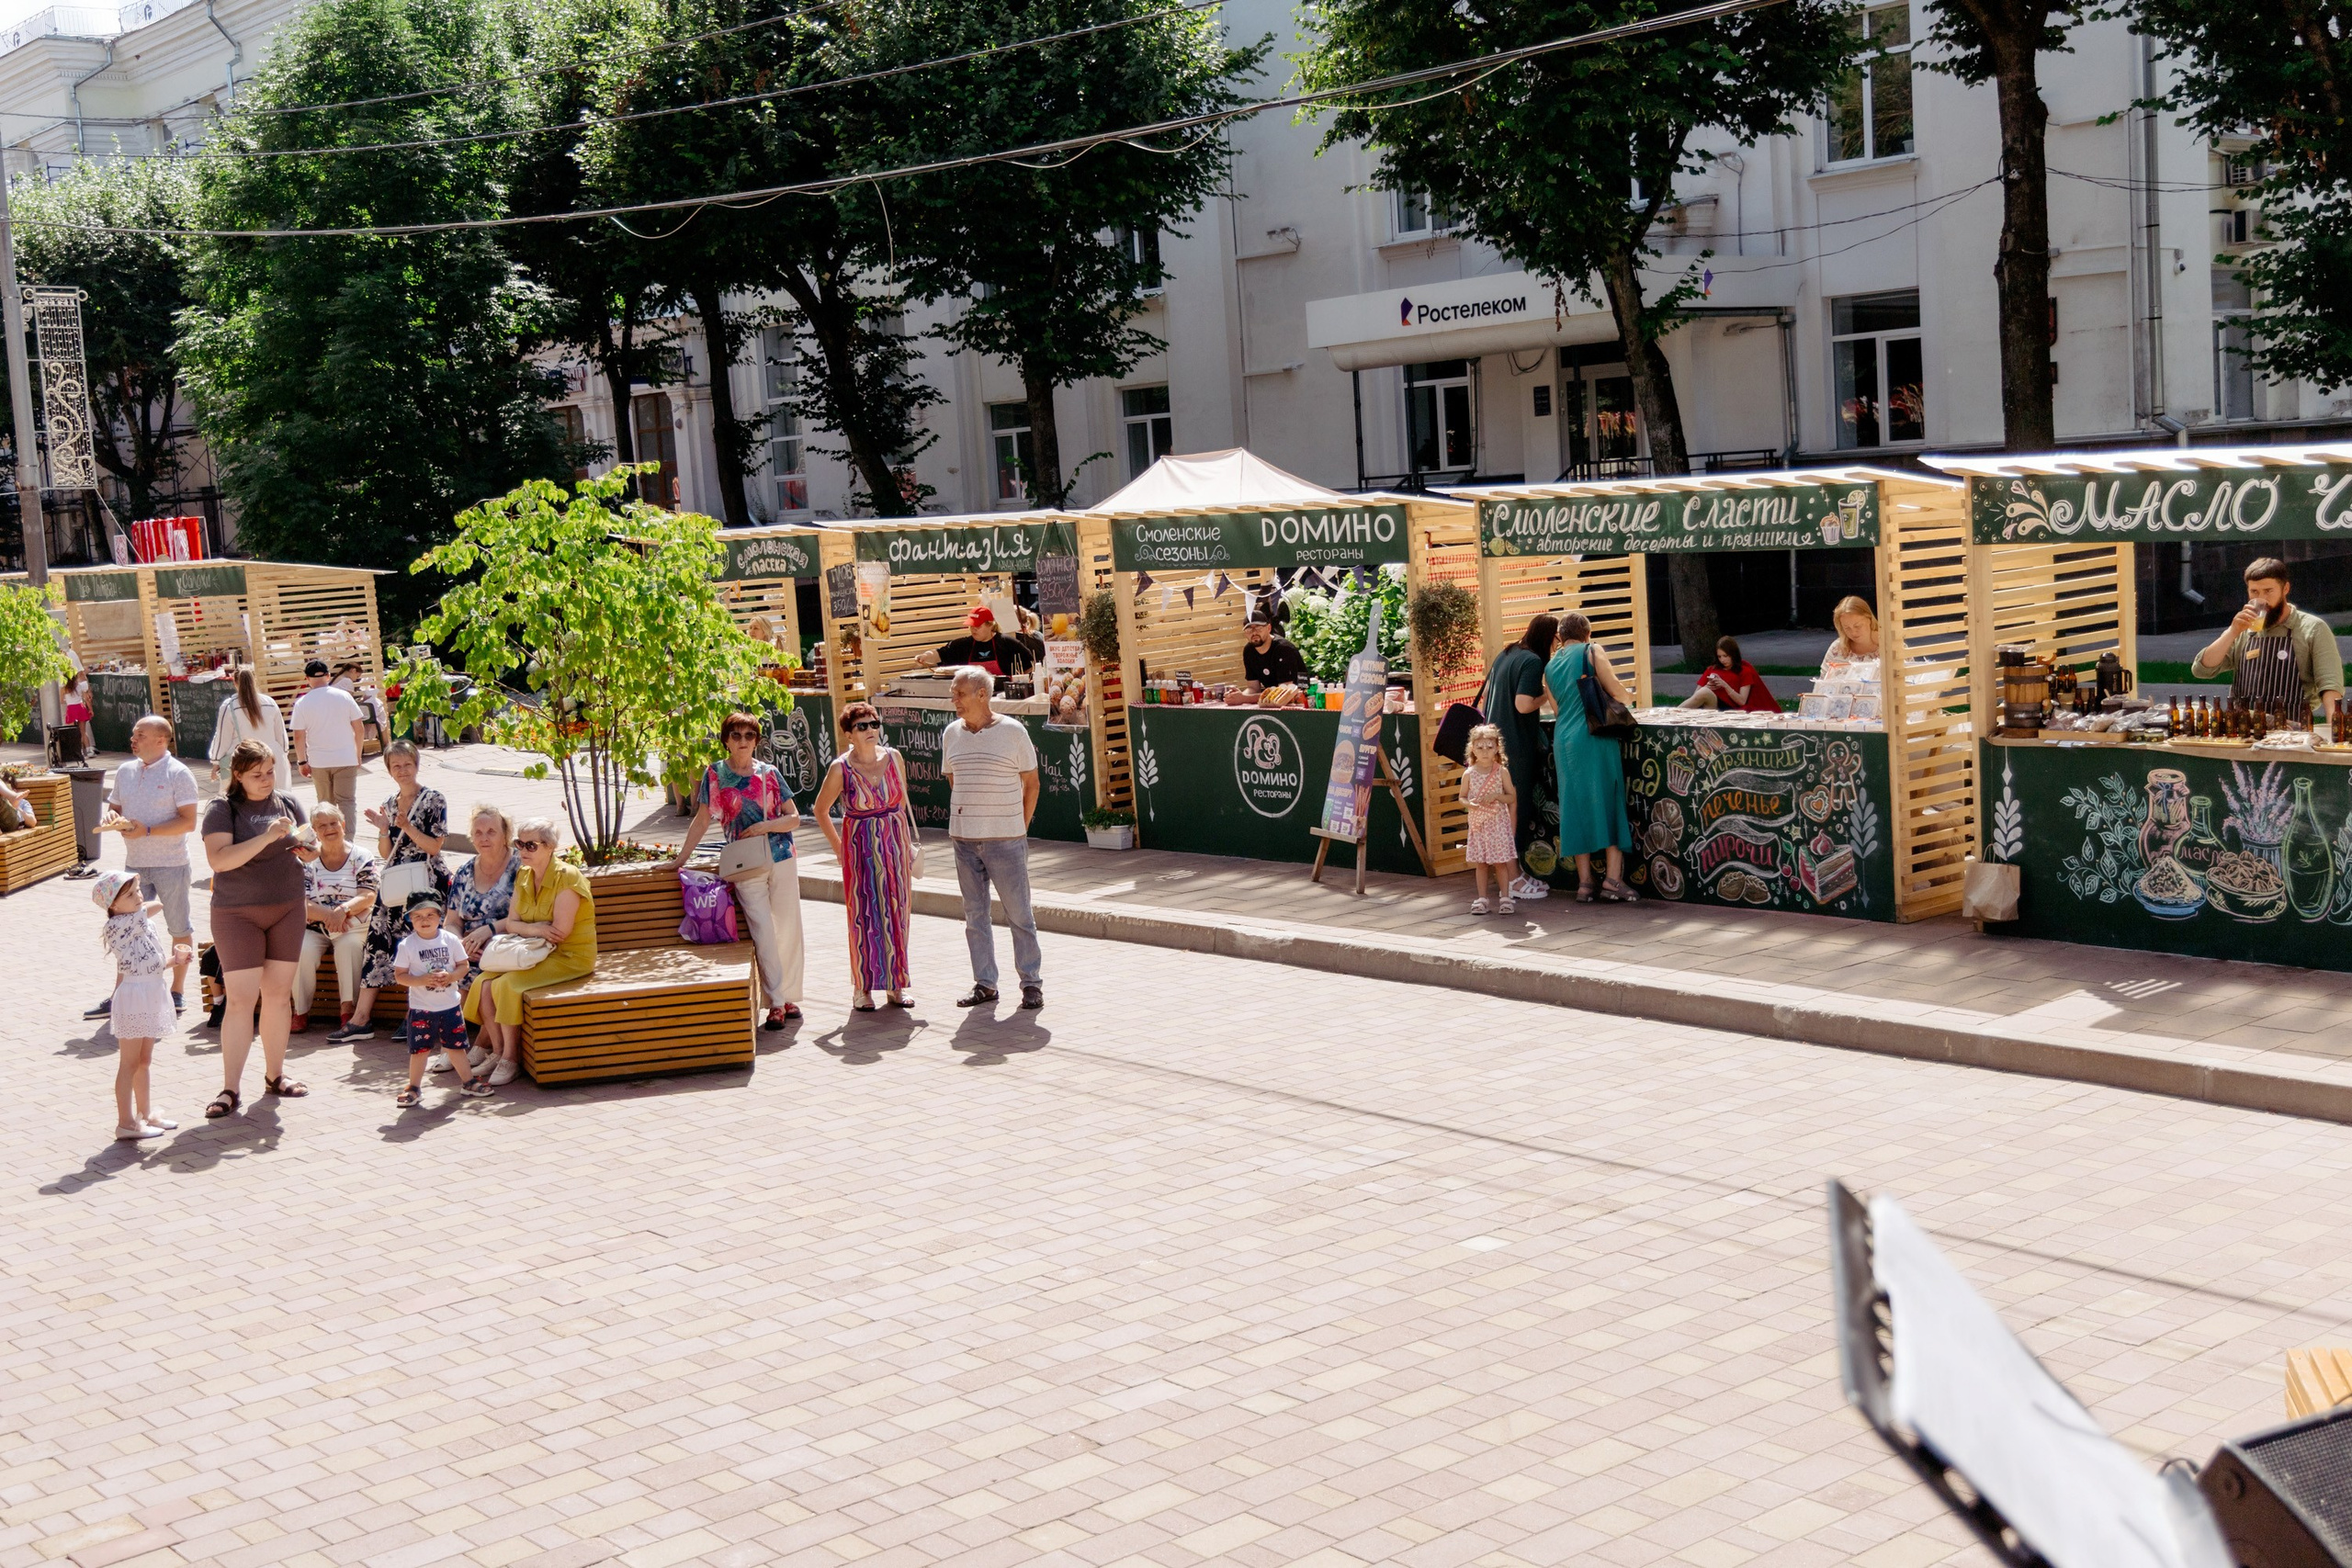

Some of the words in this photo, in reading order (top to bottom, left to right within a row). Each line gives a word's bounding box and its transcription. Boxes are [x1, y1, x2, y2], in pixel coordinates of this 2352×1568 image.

[1418, 297, 1526, 324] Ростелеком
[1493, 501, 1660, 538] Смоленские
[1682, 495, 1801, 531] Сласти
[2048, 474, 2280, 536] МАСЛО
[1136, 525, 1221, 543] Смоленские
[1536, 533, 1613, 554] авторские
[1623, 533, 1697, 553] десерты
[1702, 535, 1714, 547] и
[1722, 530, 1799, 550] пряники
[1154, 545, 1210, 561] сезоны
[897, 727, 944, 751] ДРАНИК
[776, 751, 797, 778] МЁД
[1041, 753, 1063, 776] Чай
[1712, 747, 1801, 778] пряники
[1702, 790, 1782, 828] печенье
[693, 895, 718, 909] WB
[418, 946, 450, 961] MONSTER
